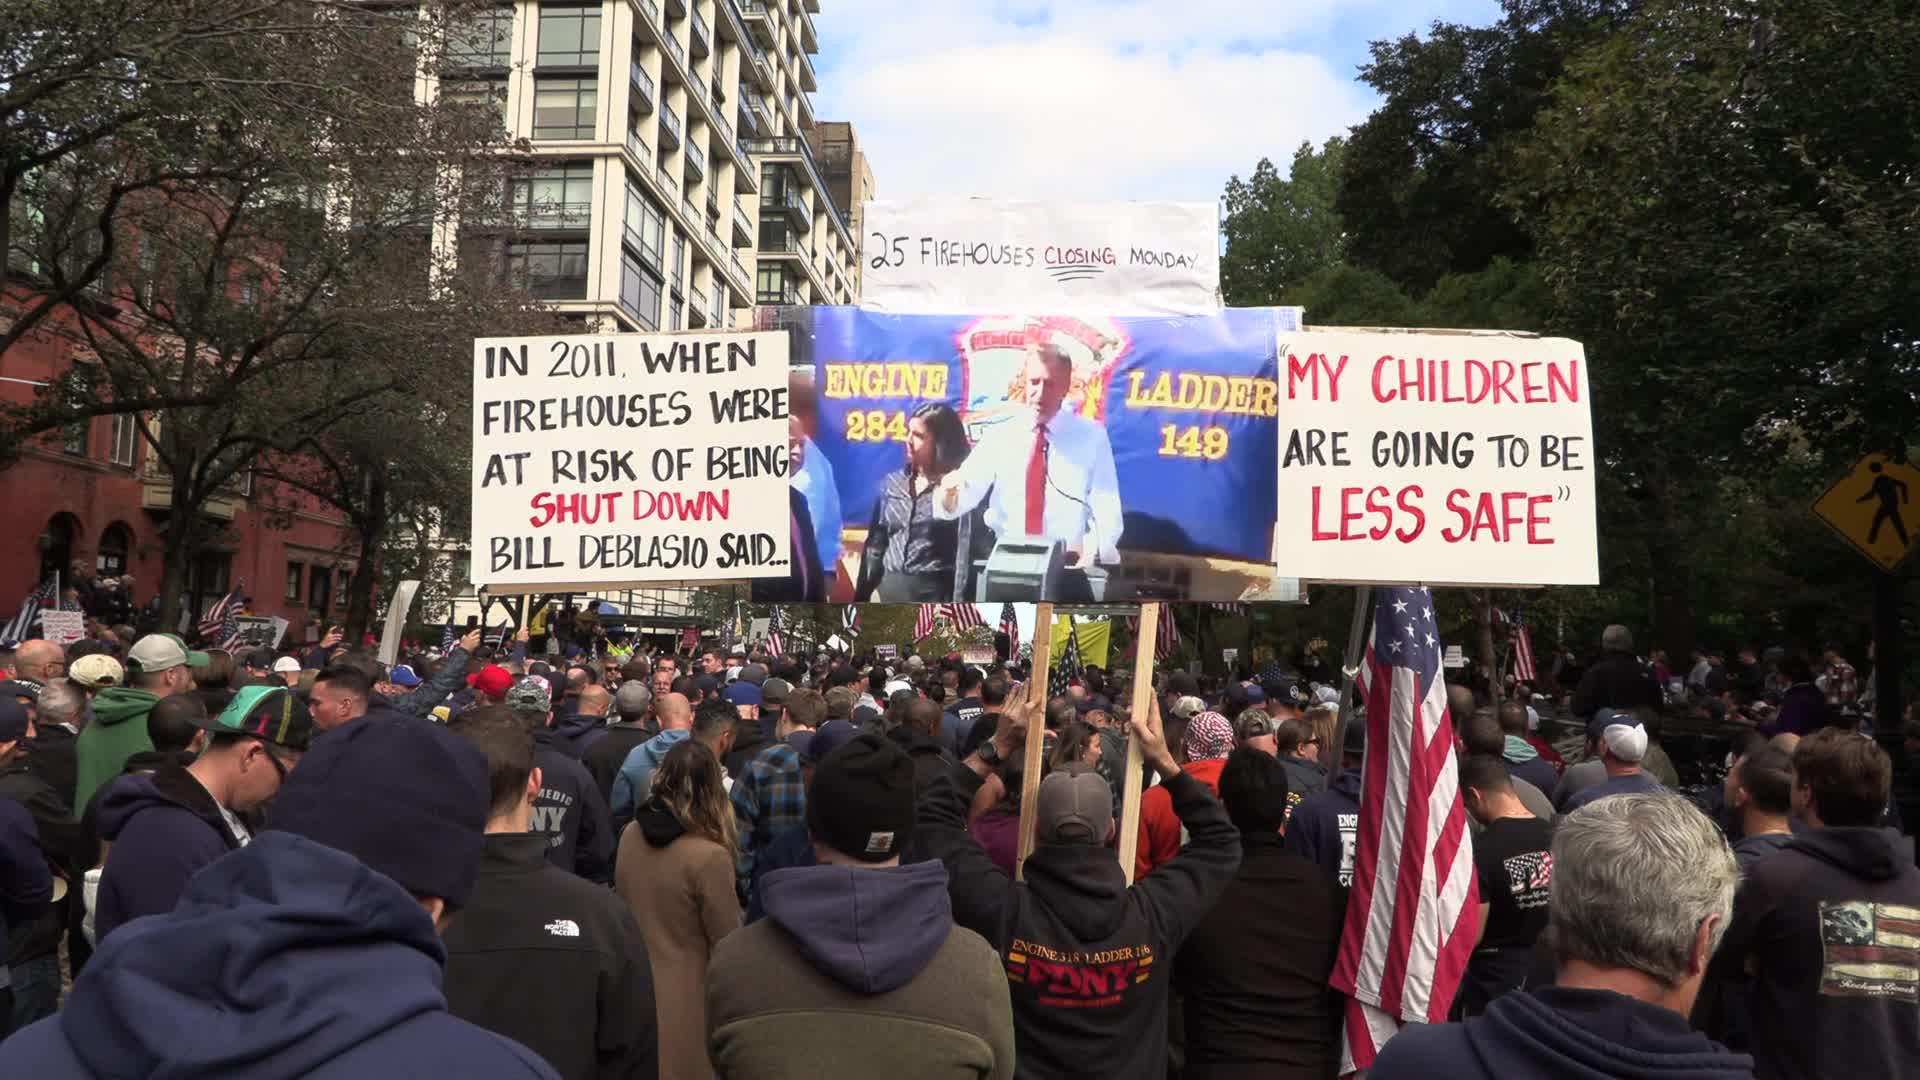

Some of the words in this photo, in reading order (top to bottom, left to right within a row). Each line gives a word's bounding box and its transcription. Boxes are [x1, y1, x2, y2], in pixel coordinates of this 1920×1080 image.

[871, 232, 908, 269] 25
[920, 236, 1034, 267] FIREHOUSES
[1044, 246, 1117, 266] CLOSING
[1129, 244, 1200, 269] MONDAY
[485, 344, 528, 378] IN
[640, 338, 757, 375] WHEN
[824, 364, 948, 399] ENGINE
[1125, 369, 1277, 416] LADDER
[1371, 355, 1579, 405] CHILDREN
[483, 390, 692, 436] FIREHOUSES
[708, 387, 789, 425] WERE
[846, 410, 907, 441] 284
[1159, 424, 1229, 460] 149
[1282, 428, 1352, 469] ARE
[1371, 430, 1475, 470] GOING
[1486, 434, 1530, 468] TO
[1540, 434, 1584, 472] BE
[481, 452, 532, 488] AT
[551, 448, 638, 484] RISK
[651, 447, 694, 482] OF
[706, 444, 789, 481] BEING
[529, 491, 623, 529] SHUT
[633, 488, 730, 522] DOWN
[1311, 484, 1426, 544] LESS
[490, 535, 565, 573] BILL
[579, 534, 709, 570] DEBLASIO
[715, 532, 789, 569] SAID...
[1012, 939, 1058, 960] ENGINE
[1085, 947, 1134, 965] LADDER
[1029, 959, 1137, 995] FDNY
